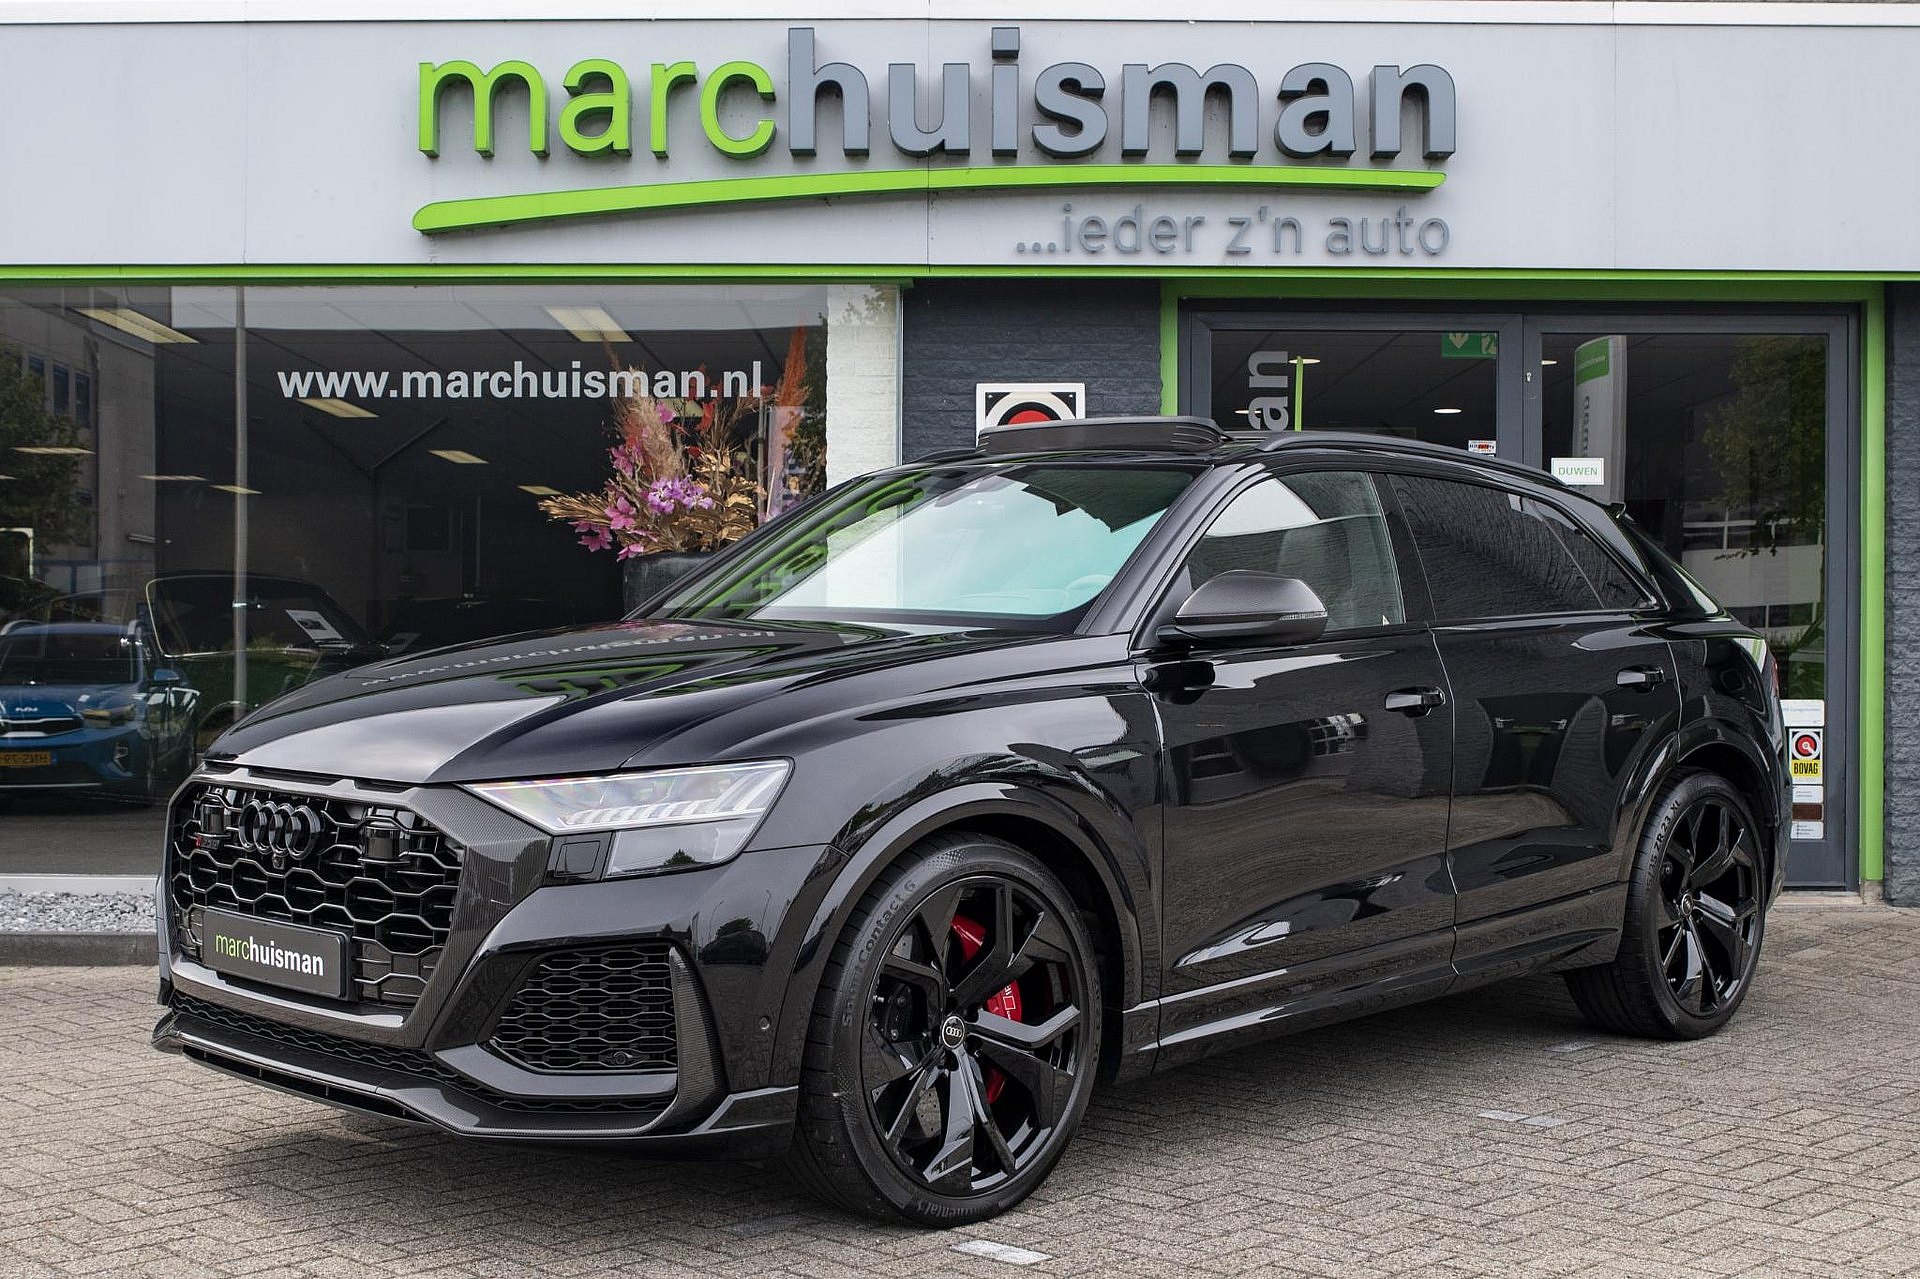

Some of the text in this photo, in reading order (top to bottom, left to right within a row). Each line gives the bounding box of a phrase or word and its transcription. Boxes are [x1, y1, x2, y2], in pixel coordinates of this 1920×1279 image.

[418, 27, 1456, 160] marchuisman
[1016, 203, 1451, 256] ...ieder z'n auto
[277, 361, 762, 398] www.marchuisman.nl
[1558, 466, 1598, 476] DUWEN
[1793, 762, 1819, 775] BOVAG
[1661, 815, 1671, 832] 23
[215, 932, 324, 976] marchuisman
